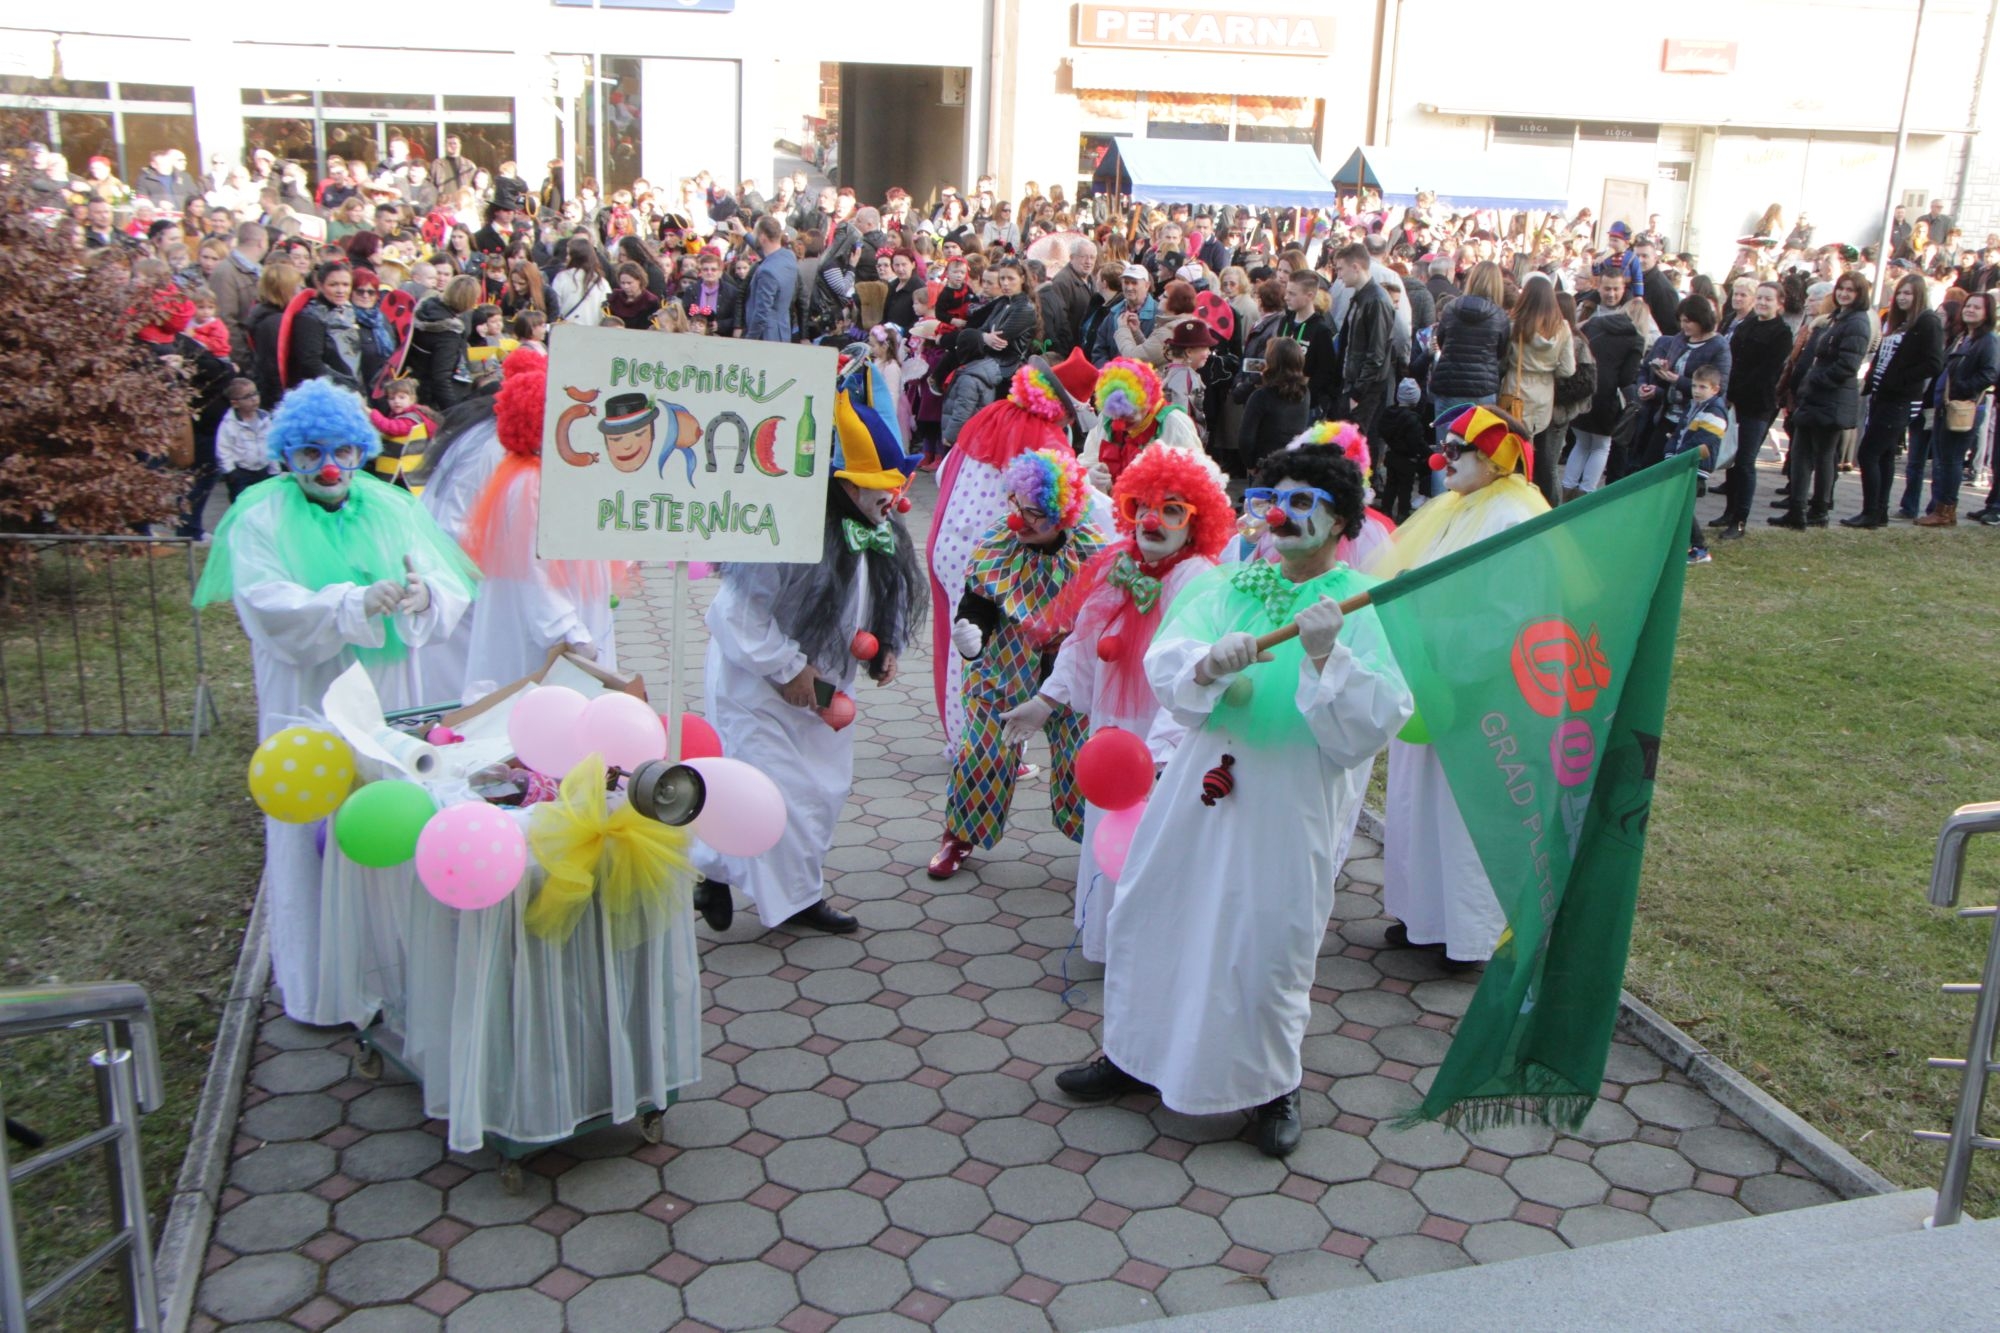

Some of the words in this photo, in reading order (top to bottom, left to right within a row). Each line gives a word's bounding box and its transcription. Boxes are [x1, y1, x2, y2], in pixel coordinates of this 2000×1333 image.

[1096, 9, 1321, 48] PEKARNA
[597, 490, 780, 546] PLETERNICA
[1480, 711, 1536, 806] GRAD
